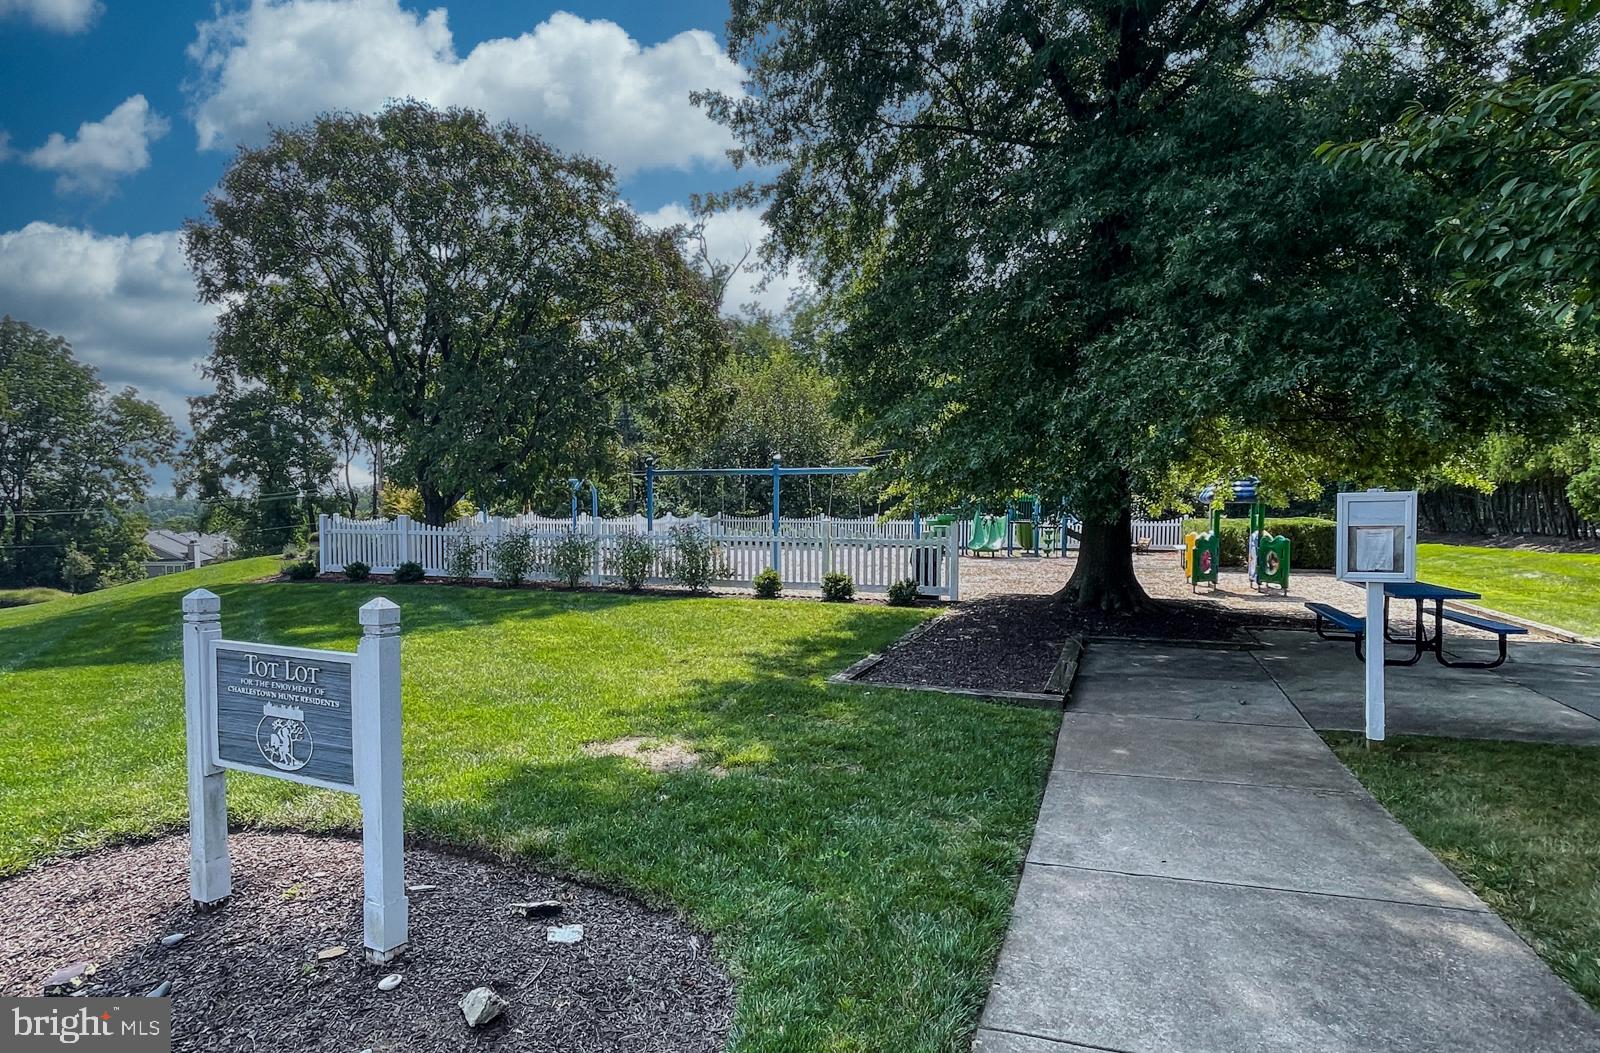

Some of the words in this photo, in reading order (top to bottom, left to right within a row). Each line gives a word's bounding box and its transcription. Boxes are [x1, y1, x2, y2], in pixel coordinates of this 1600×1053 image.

[244, 654, 279, 678] TOT
[285, 659, 319, 683] LOT
[227, 685, 277, 698] CHARLESTOWN
[278, 692, 300, 702] HUNT
[300, 695, 340, 707] RESIDENTS
[240, 678, 255, 686] FOR
[255, 679, 269, 688] THE
[271, 681, 312, 694] ENJOYMENT
[314, 687, 326, 696] OF
